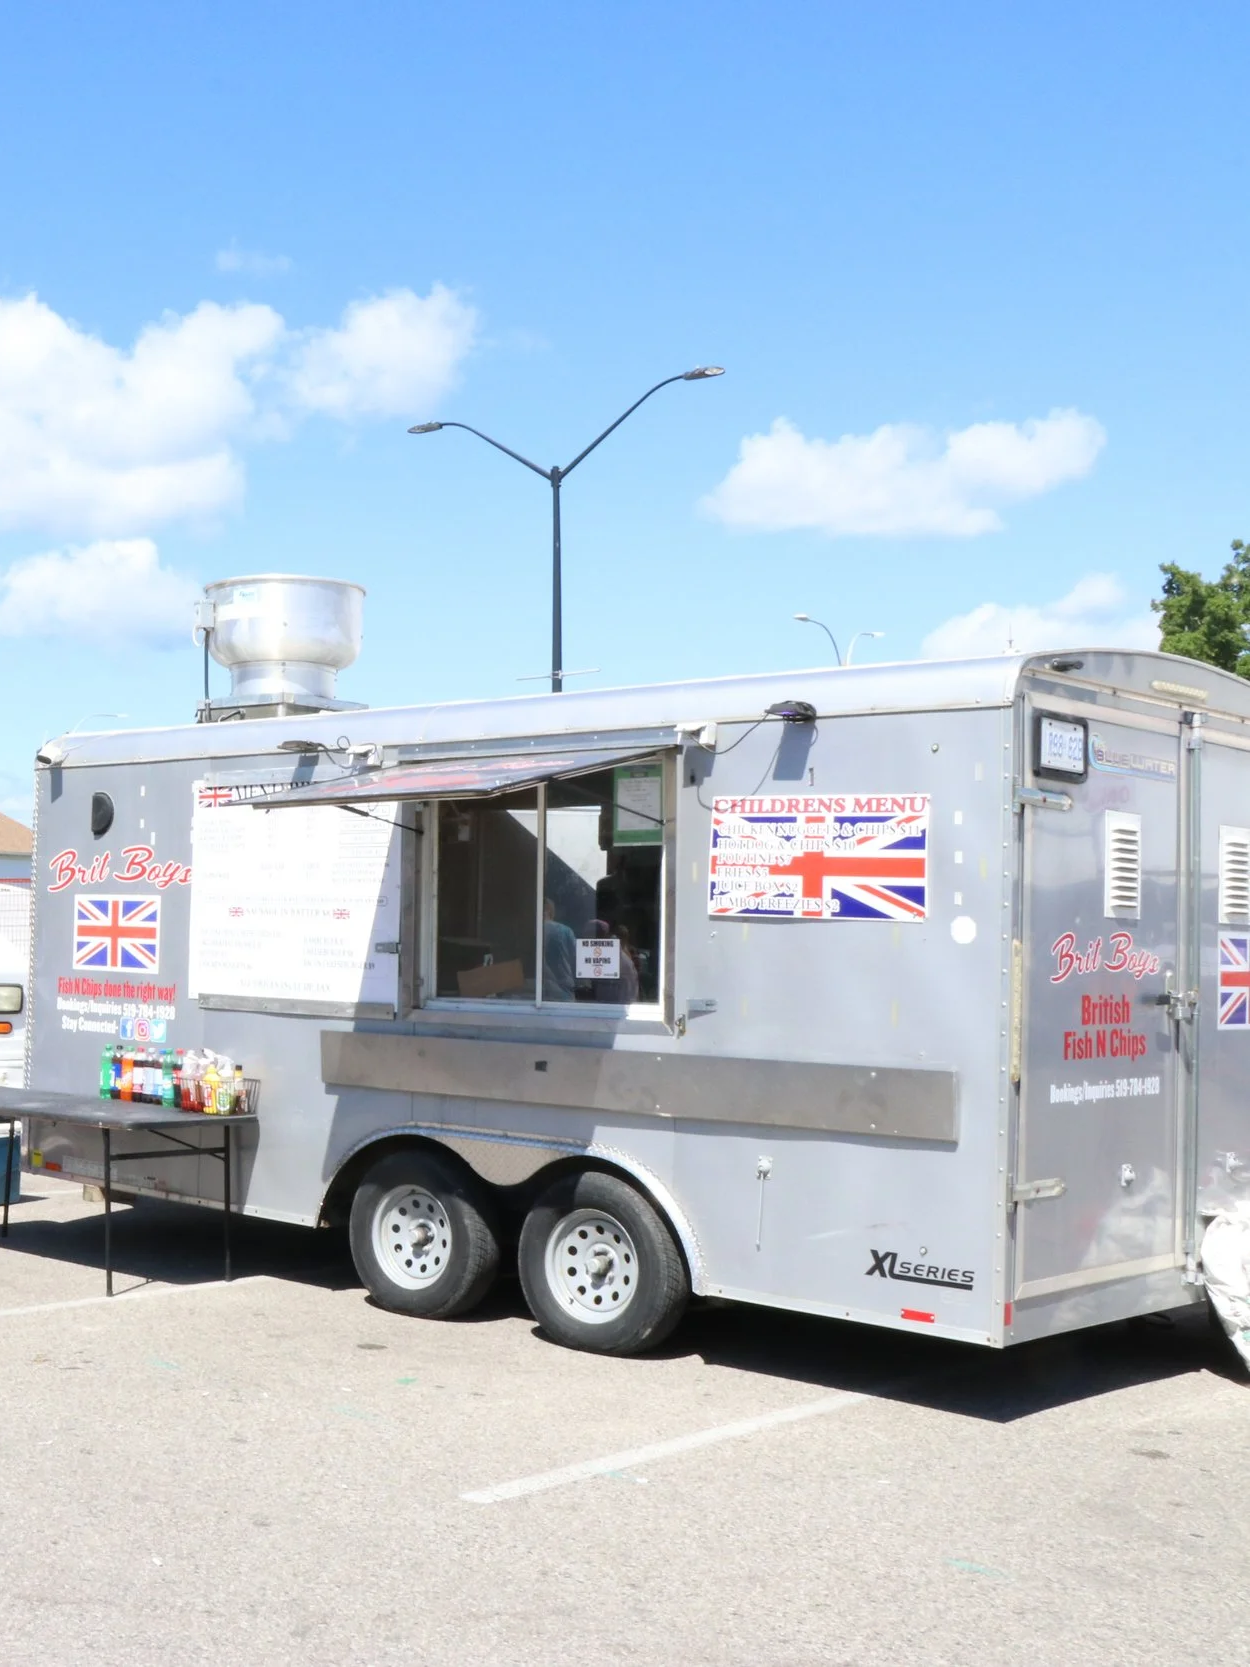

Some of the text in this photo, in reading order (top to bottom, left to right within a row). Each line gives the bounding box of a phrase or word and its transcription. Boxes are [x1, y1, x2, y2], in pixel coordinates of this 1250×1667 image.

[714, 797, 928, 814] CHILDRENS MENU
[718, 824, 778, 836] CHICKEN
[778, 824, 839, 837] NUGGETS
[841, 824, 854, 837] &
[855, 824, 897, 837] CHIPS
[790, 839, 831, 851] CHIPS
[834, 839, 856, 851] $10
[113, 845, 191, 889] Boys
[717, 853, 793, 865] POUTINE $7
[717, 866, 751, 878] FRIES
[714, 881, 799, 893] JUICE BOX $2
[713, 896, 839, 911] JUMBO FREEZIES $2
[1104, 931, 1159, 980] Boys
[57, 976, 177, 1005] Fish N Chips done the right way!
[1081, 994, 1131, 1026] British
[61, 1015, 78, 1032] Stay
[1063, 1028, 1147, 1061] Fish N Chips
[898, 1261, 975, 1284] SERIES
